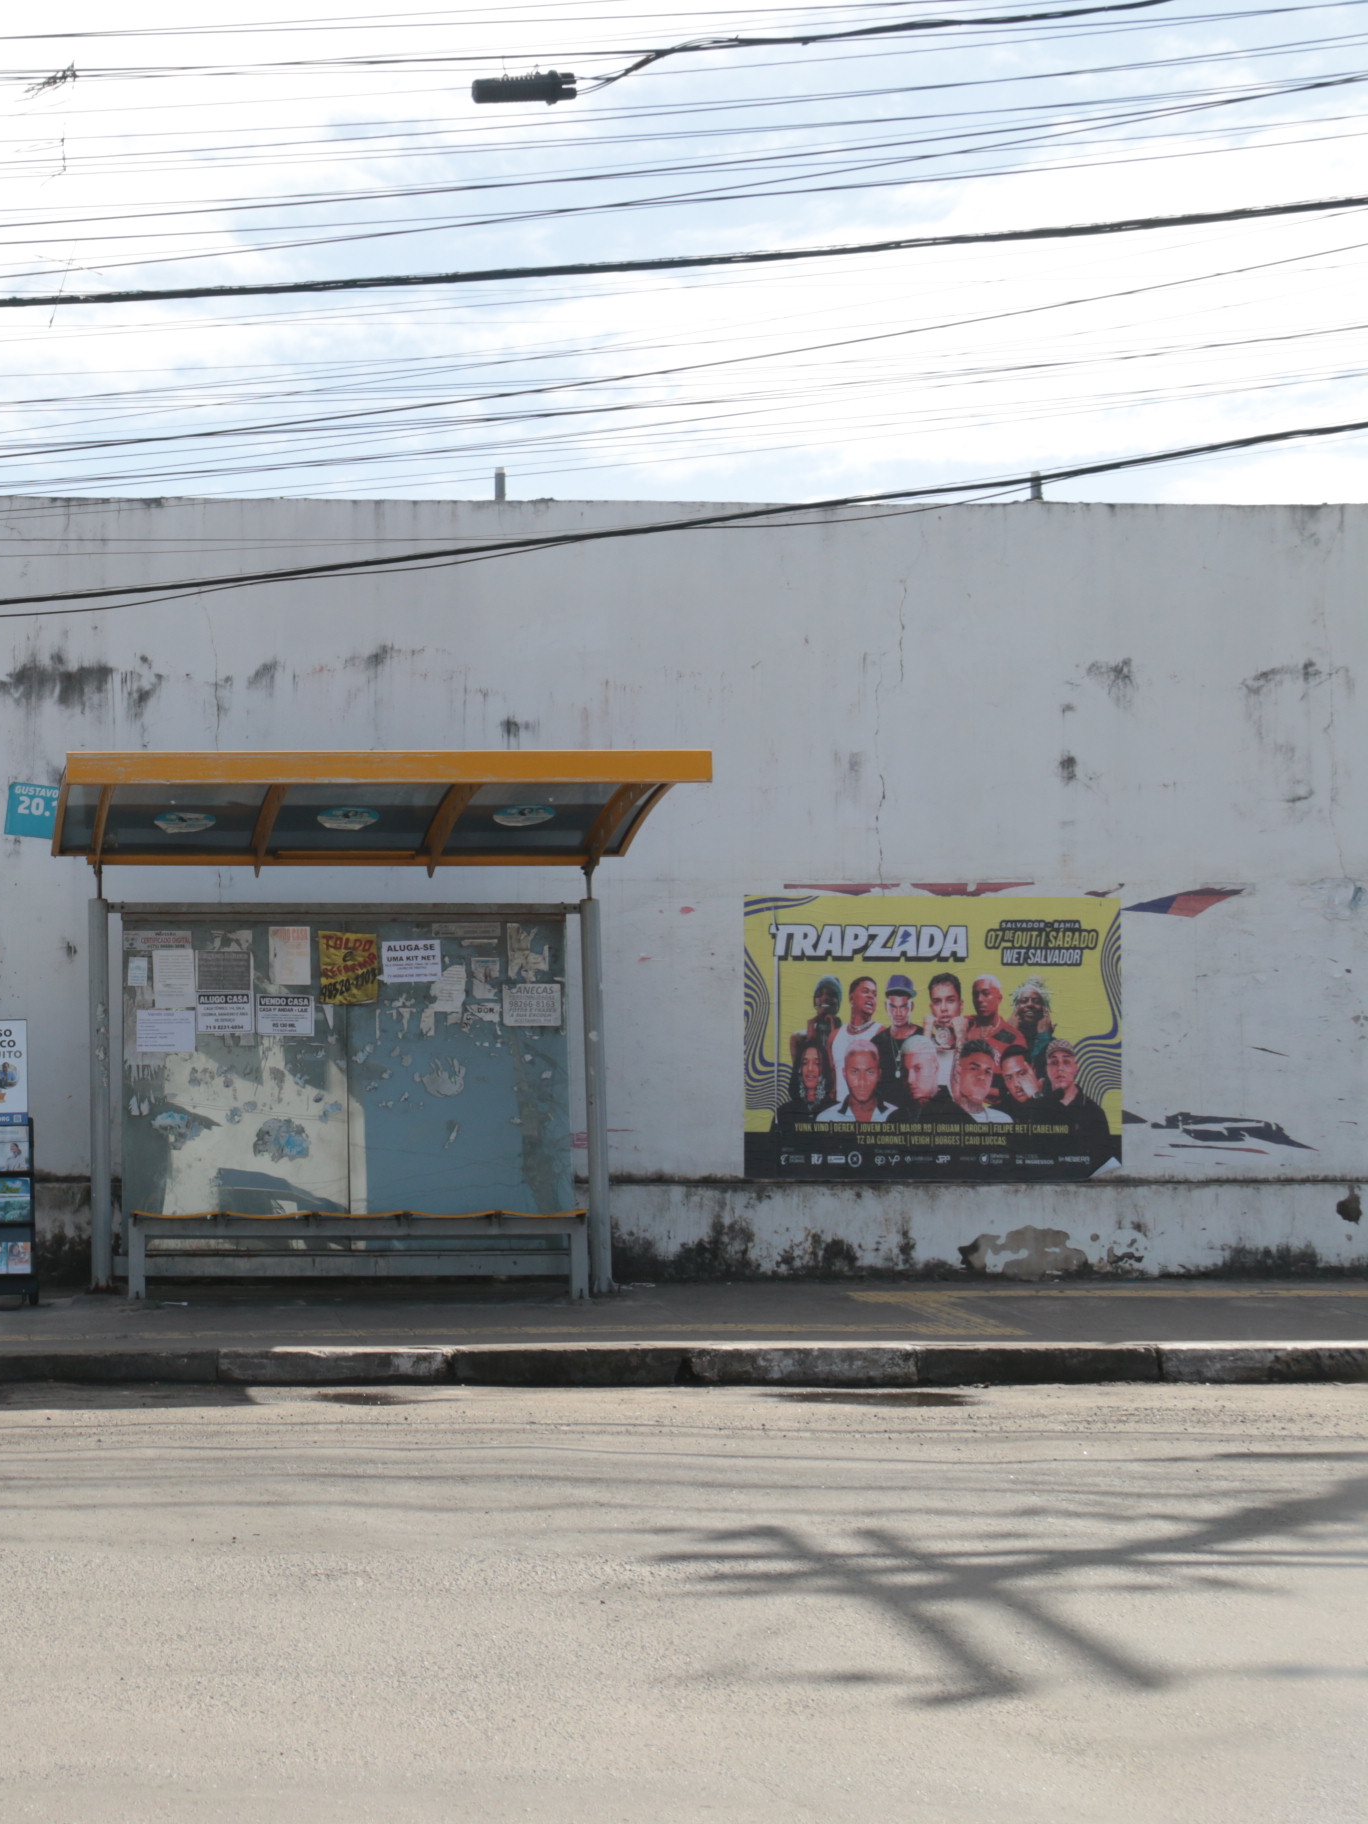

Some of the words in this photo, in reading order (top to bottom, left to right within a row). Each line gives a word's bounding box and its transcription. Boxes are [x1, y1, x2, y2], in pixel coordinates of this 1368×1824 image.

[15, 785, 59, 798] GUSTAVO
[17, 795, 58, 817] 20.
[141, 936, 170, 944] CERTIFICADO
[172, 936, 190, 944] DIGITAL
[770, 924, 968, 961] TRAPZADA
[986, 931, 1003, 947] 07
[1004, 930, 1014, 940] DE
[1048, 929, 1097, 948] SÁBADO
[322, 934, 375, 953] TOLDO
[387, 943, 436, 952] ALUGA-SE
[1003, 949, 1027, 964] WET
[1027, 949, 1082, 964] SALVADOR
[322, 952, 377, 980] REFORMA
[200, 995, 226, 1003] ALUGO
[227, 995, 248, 1003] CASA
[260, 997, 286, 1005] VENDO
[287, 998, 309, 1006] CASA
[794, 1123, 812, 1132] YUNK
[834, 1123, 855, 1132] DEREK
[859, 1123, 881, 1132] JOVEM
[882, 1123, 895, 1132] DEX
[900, 1123, 921, 1132] MAJOR
[964, 1124, 989, 1133] OROCHI
[993, 1125, 1014, 1133] FILIPE
[1015, 1125, 1027, 1133] RET
[1032, 1125, 1069, 1134] CABELINHO
[856, 1135, 864, 1144] TZ
[876, 1135, 906, 1144] CORONEL
[910, 1135, 930, 1145] VEIGH
[935, 1136, 960, 1145] BORGES
[964, 1136, 980, 1145] CAIO
[981, 1136, 1007, 1145] LUCCAS
